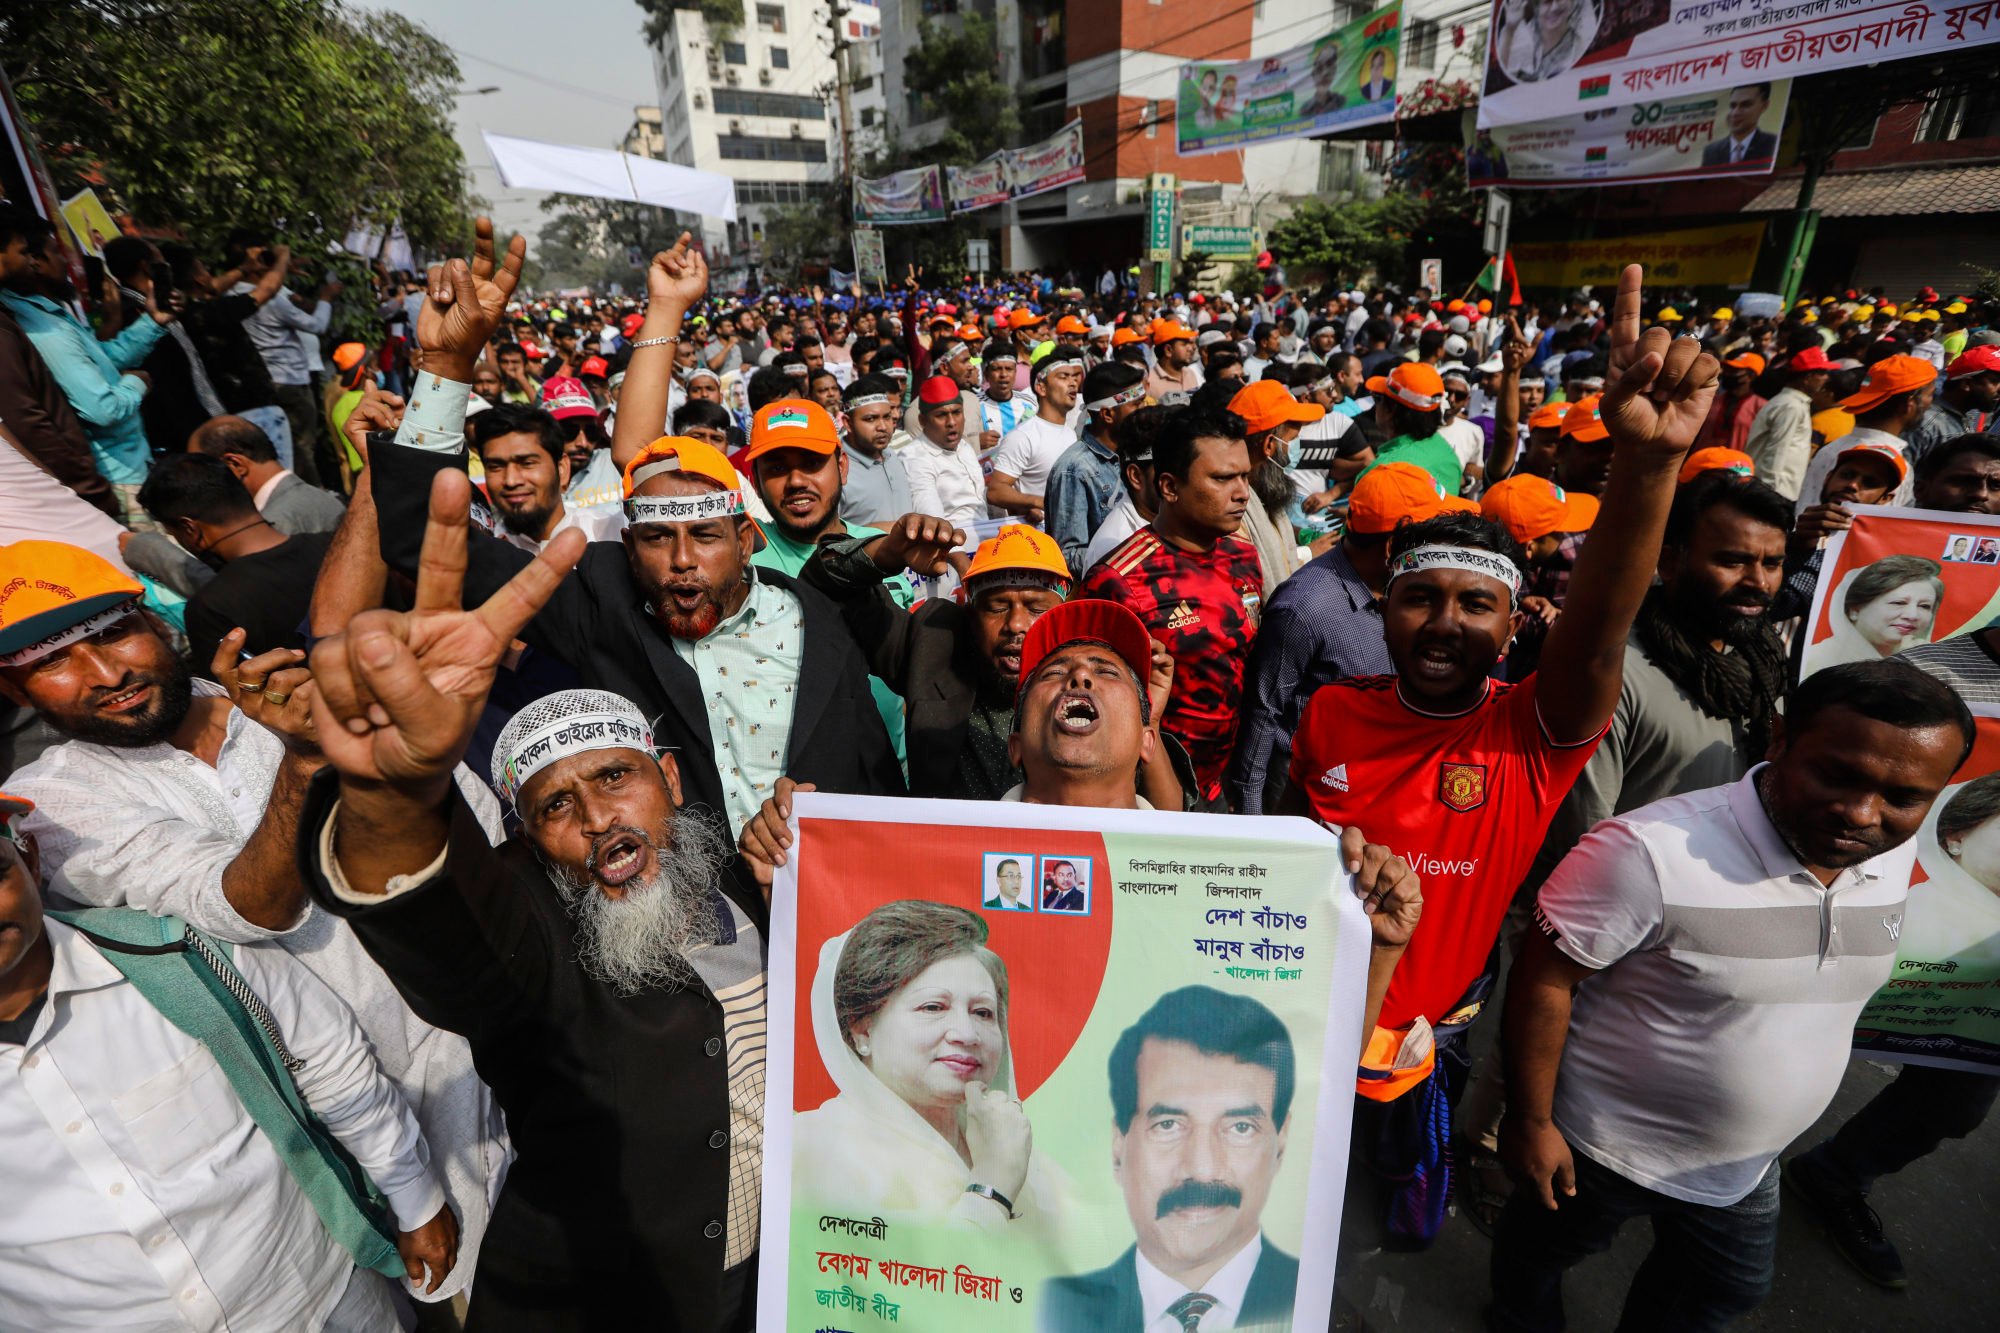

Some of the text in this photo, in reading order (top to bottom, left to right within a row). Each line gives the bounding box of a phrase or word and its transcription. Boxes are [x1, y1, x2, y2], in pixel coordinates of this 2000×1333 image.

[1623, 1, 2000, 93] বাংলাদেশ জাতীয়তাবাদী যুব
[1632, 102, 1662, 126] ১০
[1157, 191, 1169, 248] QUALITY
[659, 499, 694, 517] ভাইয়ের
[697, 496, 716, 519] মুক্তি
[717, 495, 726, 510] চাই
[1451, 550, 1491, 570] ভাইয়ের
[1168, 614, 1200, 629] adidas
[513, 718, 642, 775] খোকন ভাইয়ের মুক্তি চাই
[1321, 775, 1349, 793] adidas
[1129, 859, 1267, 878] বিসমিল্লাহির রাহমানির রাহীম
[1118, 881, 1263, 900] বাংলাদেশ জিন্দাবাদ
[1205, 906, 1307, 930] দেশ বাঁচাও
[1193, 938, 1305, 962] মানুষ বাঁচাও
[1225, 966, 1270, 981] খালেদা
[1275, 966, 1303, 981] জিয়া
[1899, 960, 1959, 974] দেশনেত্রী
[1888, 979, 1933, 989] বেগম
[819, 1215, 888, 1240] দেশনেত্রী
[816, 1251, 1023, 1304] বেগম খালেদা জিয়া ও
[815, 1285, 900, 1322] জাতীয় বীর
